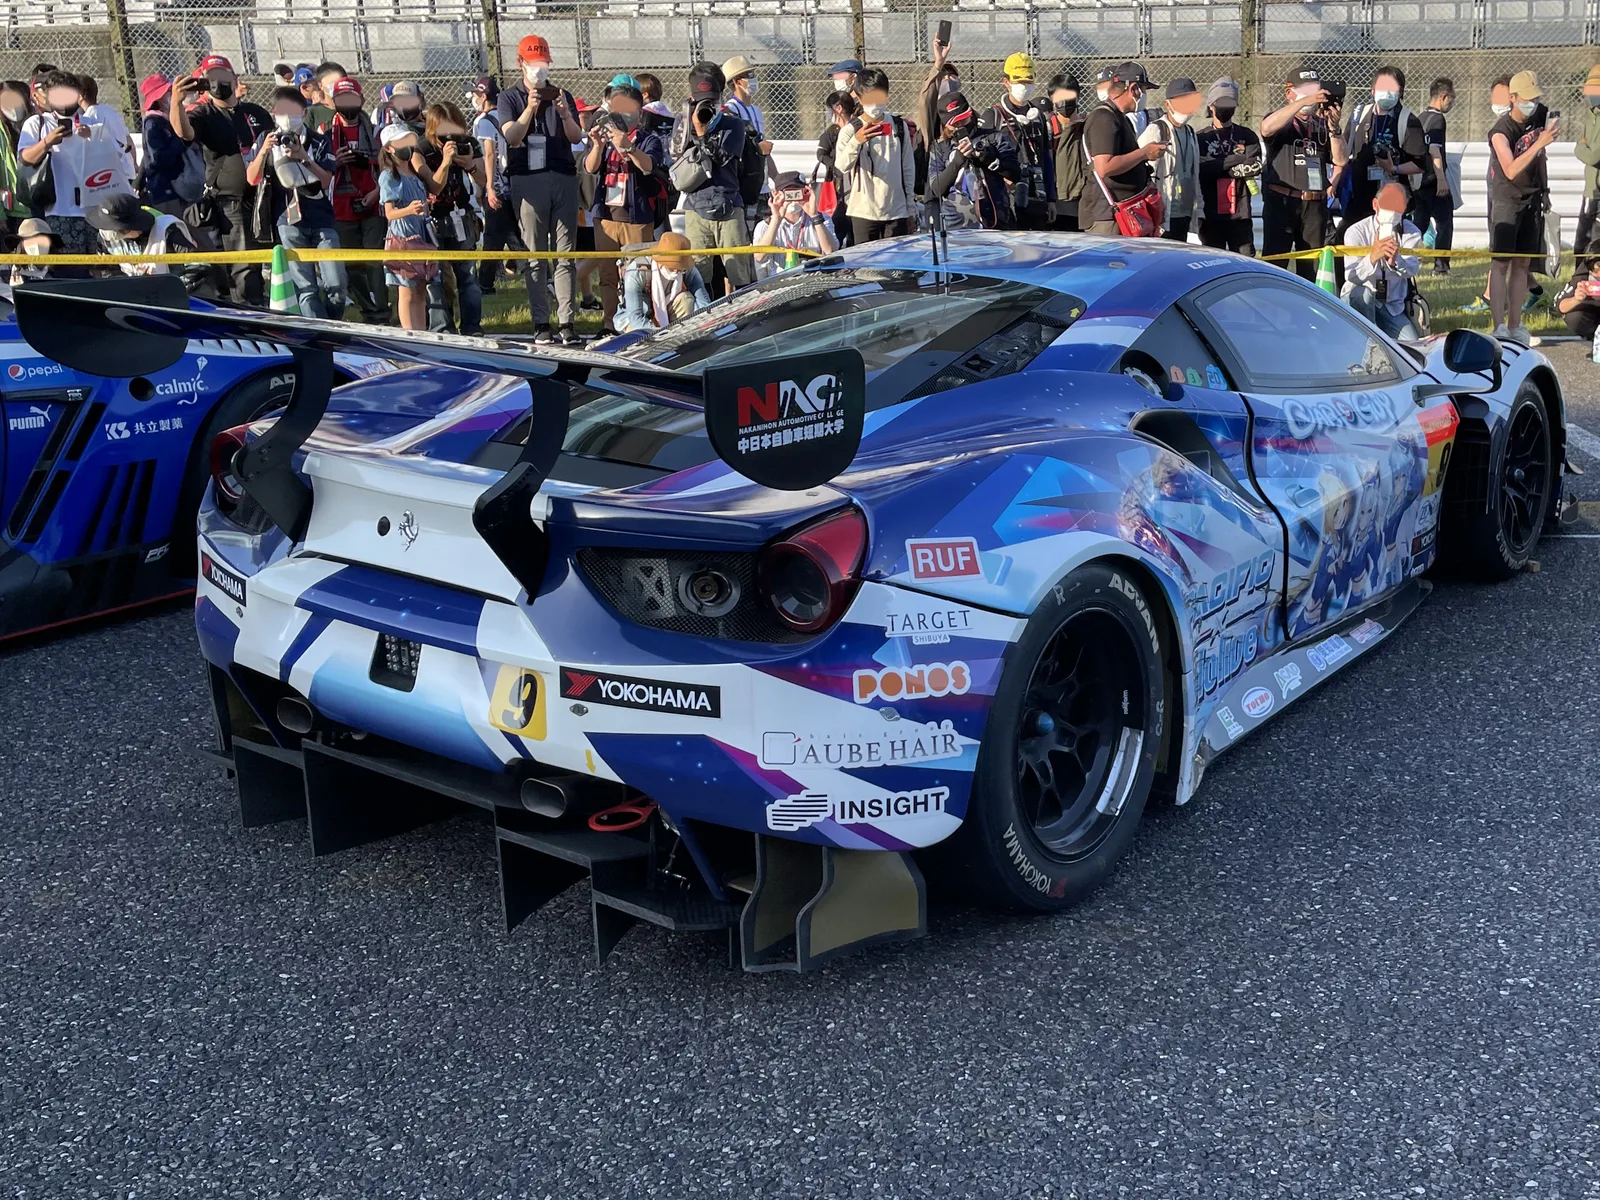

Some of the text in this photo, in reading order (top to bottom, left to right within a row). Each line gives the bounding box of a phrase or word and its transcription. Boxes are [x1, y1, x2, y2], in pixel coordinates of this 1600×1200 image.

[28, 363, 63, 378] pepsi
[155, 377, 206, 396] calmic
[9, 415, 45, 431] PUMA
[134, 417, 184, 434] 共立製薬
[737, 420, 845, 455] 中日本自動車短期大学
[738, 421, 778, 435] NAKANIHON
[778, 413, 817, 428] AUTOMOTIVE
[915, 546, 971, 573] RUF
[211, 562, 244, 600] YOKOHAMA
[886, 609, 971, 632] TARGET
[1108, 573, 1160, 655] ADVAN
[914, 634, 949, 643] SHIBUYA
[597, 679, 712, 711] YOKOHAMA
[857, 665, 967, 699] PONOS
[502, 673, 538, 730] 9
[802, 733, 958, 765] AUBE HAIR
[840, 791, 945, 820] INSIGHT
[1002, 822, 1053, 896] YOKOHAMA
